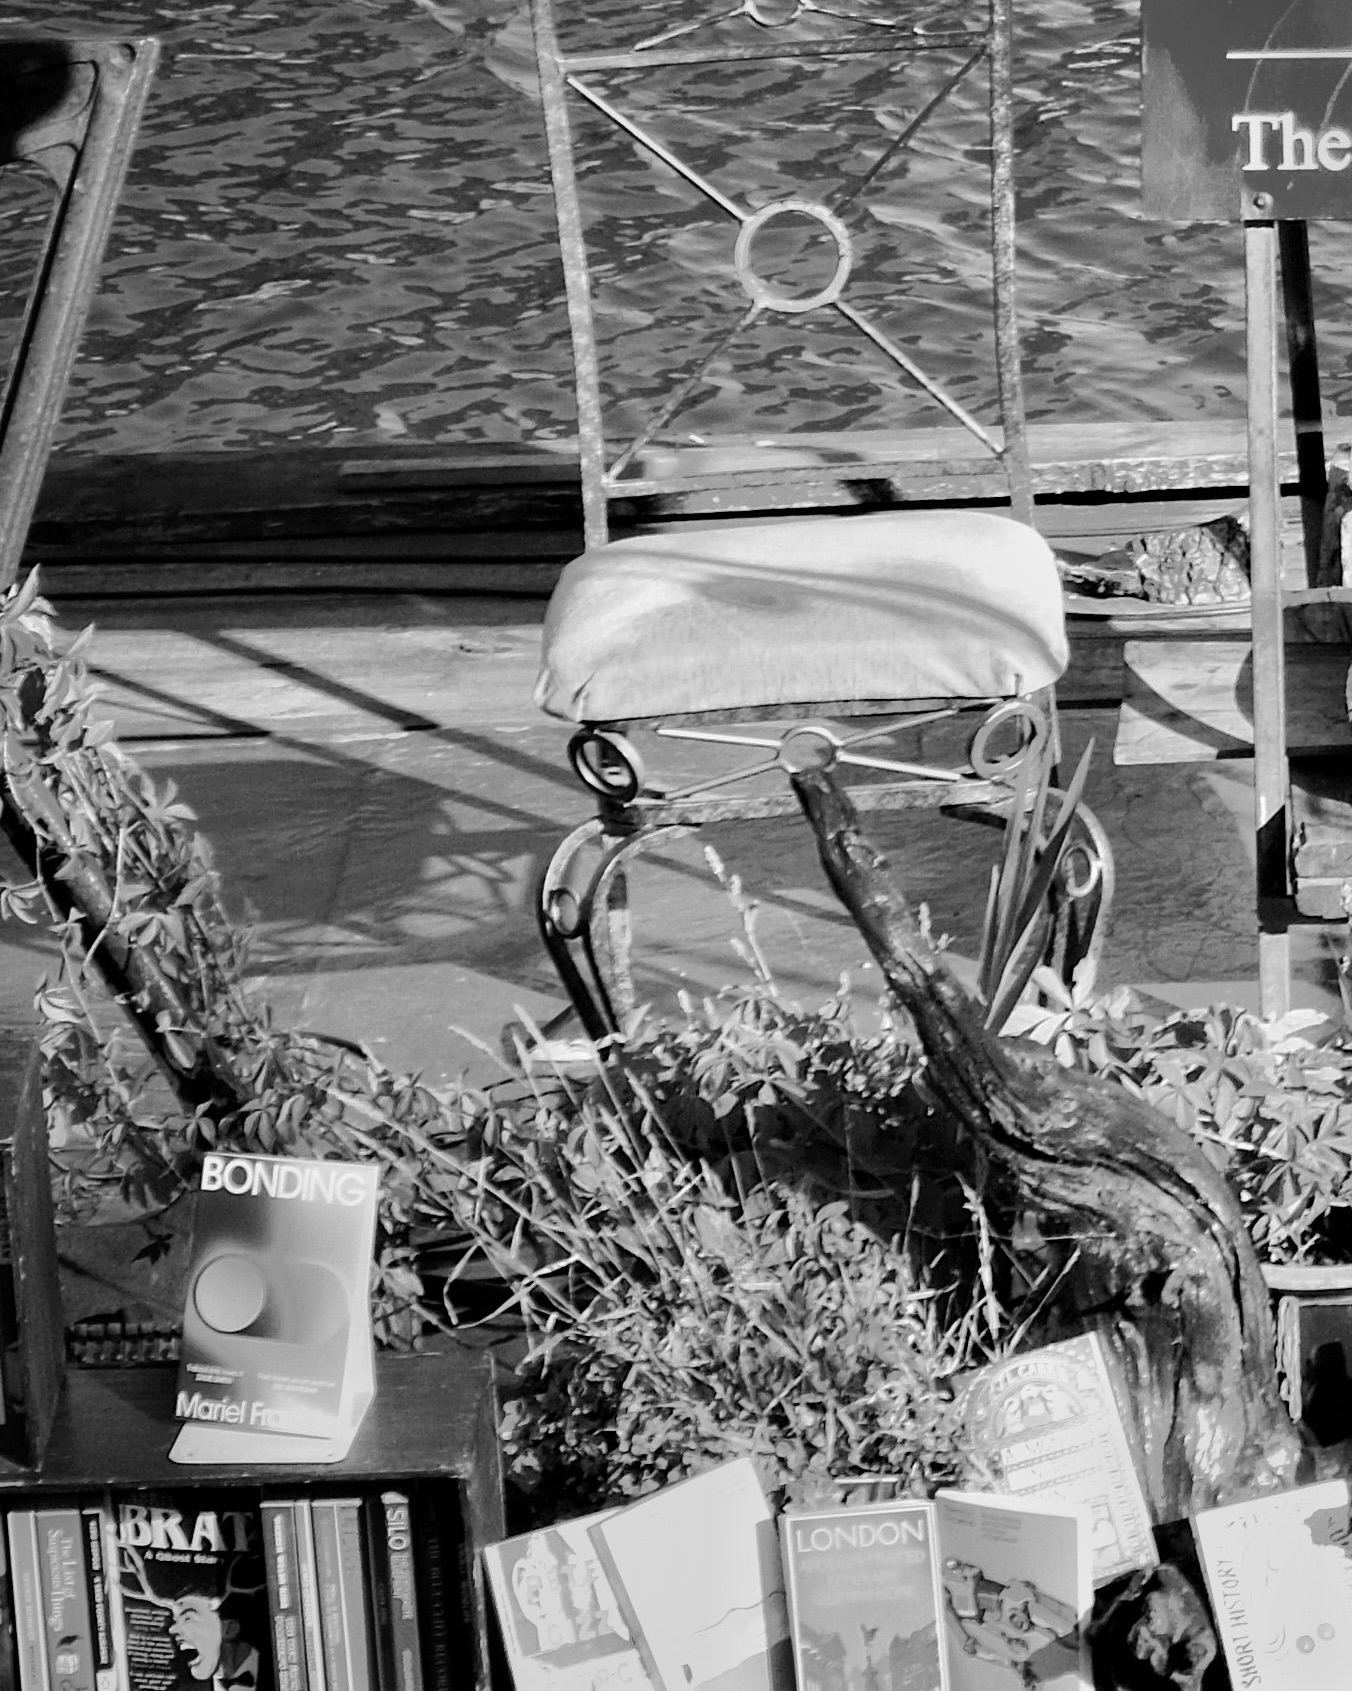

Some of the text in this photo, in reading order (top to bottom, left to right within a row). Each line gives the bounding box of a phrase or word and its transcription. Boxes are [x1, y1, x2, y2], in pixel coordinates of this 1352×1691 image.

[1231, 112, 1352, 173] The
[201, 1156, 367, 1207] BONDING
[175, 1391, 246, 1425] Mariel
[118, 1504, 255, 1552] BRAT
[386, 1508, 410, 1551] SILO
[796, 1519, 926, 1553] LONDON
[1214, 1559, 1250, 1628] HISTORY
[1231, 1635, 1263, 1689] SHORT
